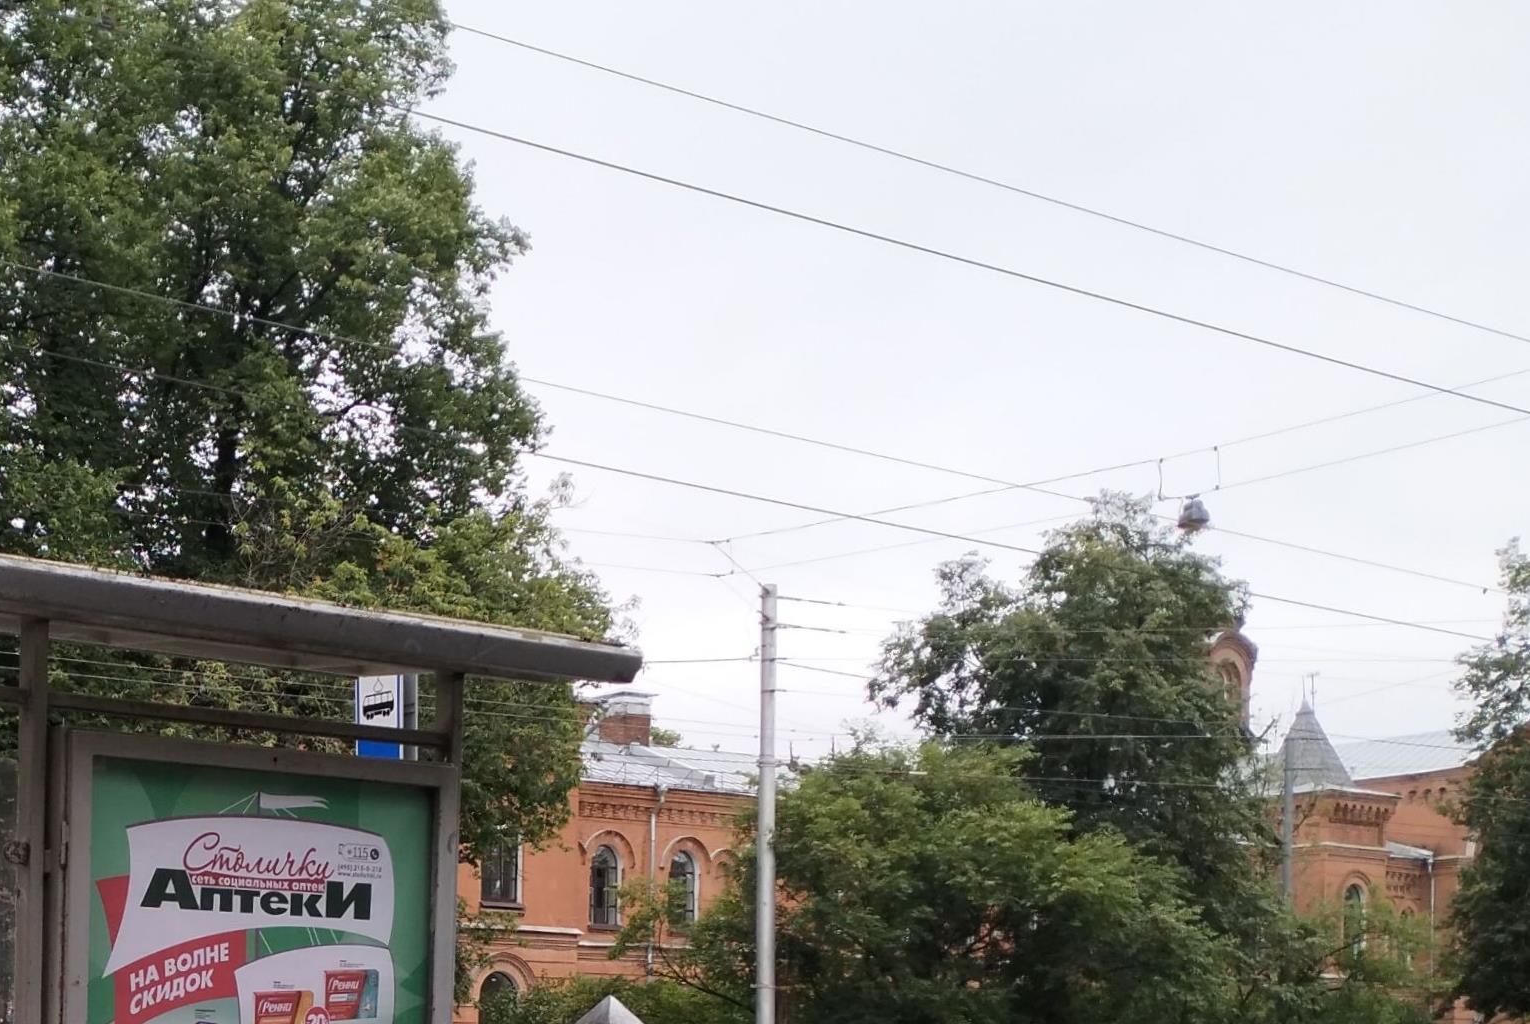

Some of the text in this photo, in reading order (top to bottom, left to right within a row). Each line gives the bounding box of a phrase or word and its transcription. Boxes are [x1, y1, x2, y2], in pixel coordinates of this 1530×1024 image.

[183, 832, 334, 879] Столички
[191, 874, 216, 886] сеть
[218, 876, 290, 891] социальных
[130, 942, 230, 992] НА ВОЛНЕ
[130, 968, 214, 1015] СКИДОК
